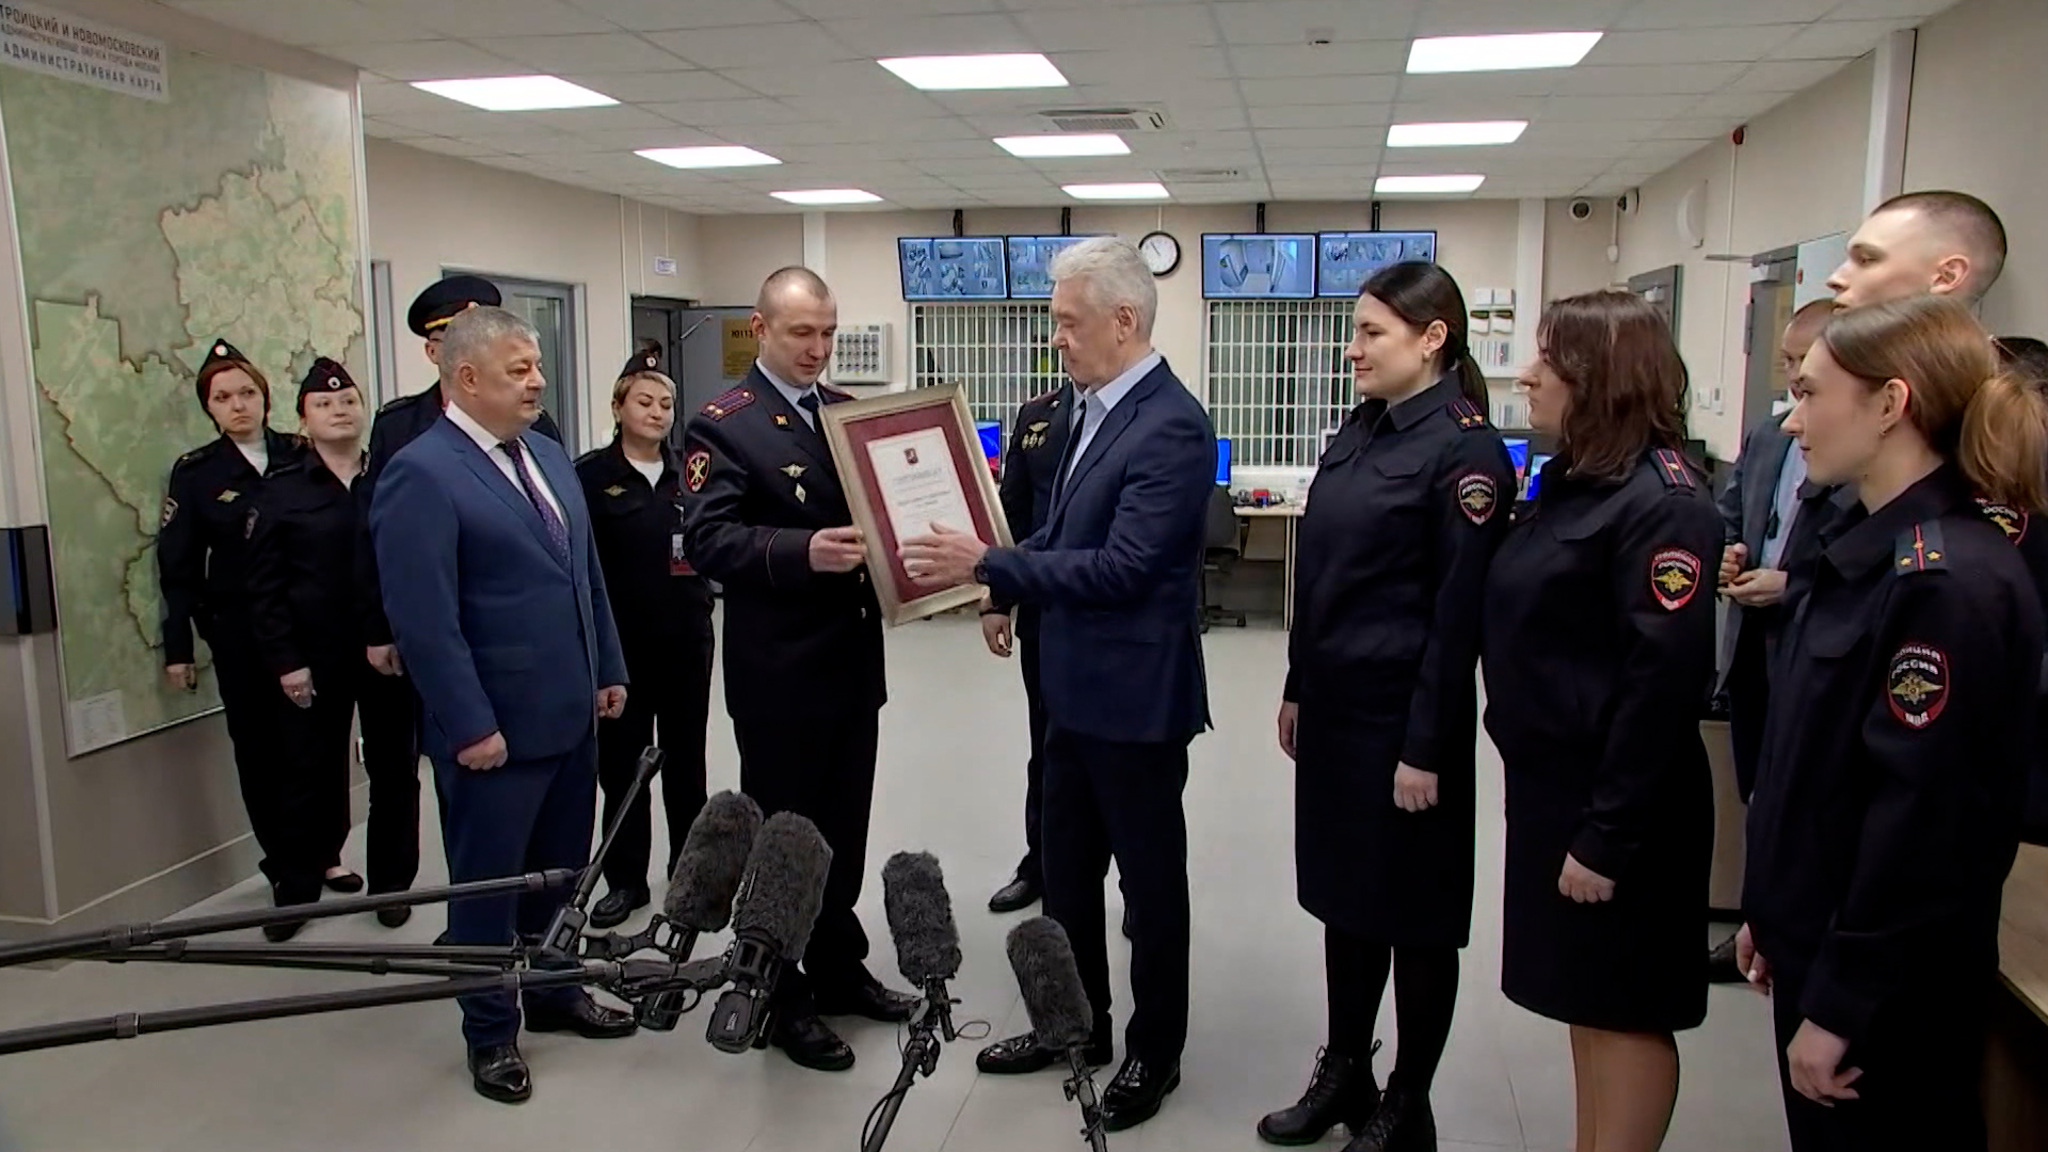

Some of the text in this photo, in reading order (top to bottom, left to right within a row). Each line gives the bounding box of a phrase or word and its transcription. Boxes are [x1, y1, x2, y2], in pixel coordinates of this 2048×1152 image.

[0, 4, 160, 61] ТРОИЦКИЙ И НОВОМОСКОВСКИЙ
[3, 41, 162, 93] АДМИНИСТРАТИВНАЯ КАРТА
